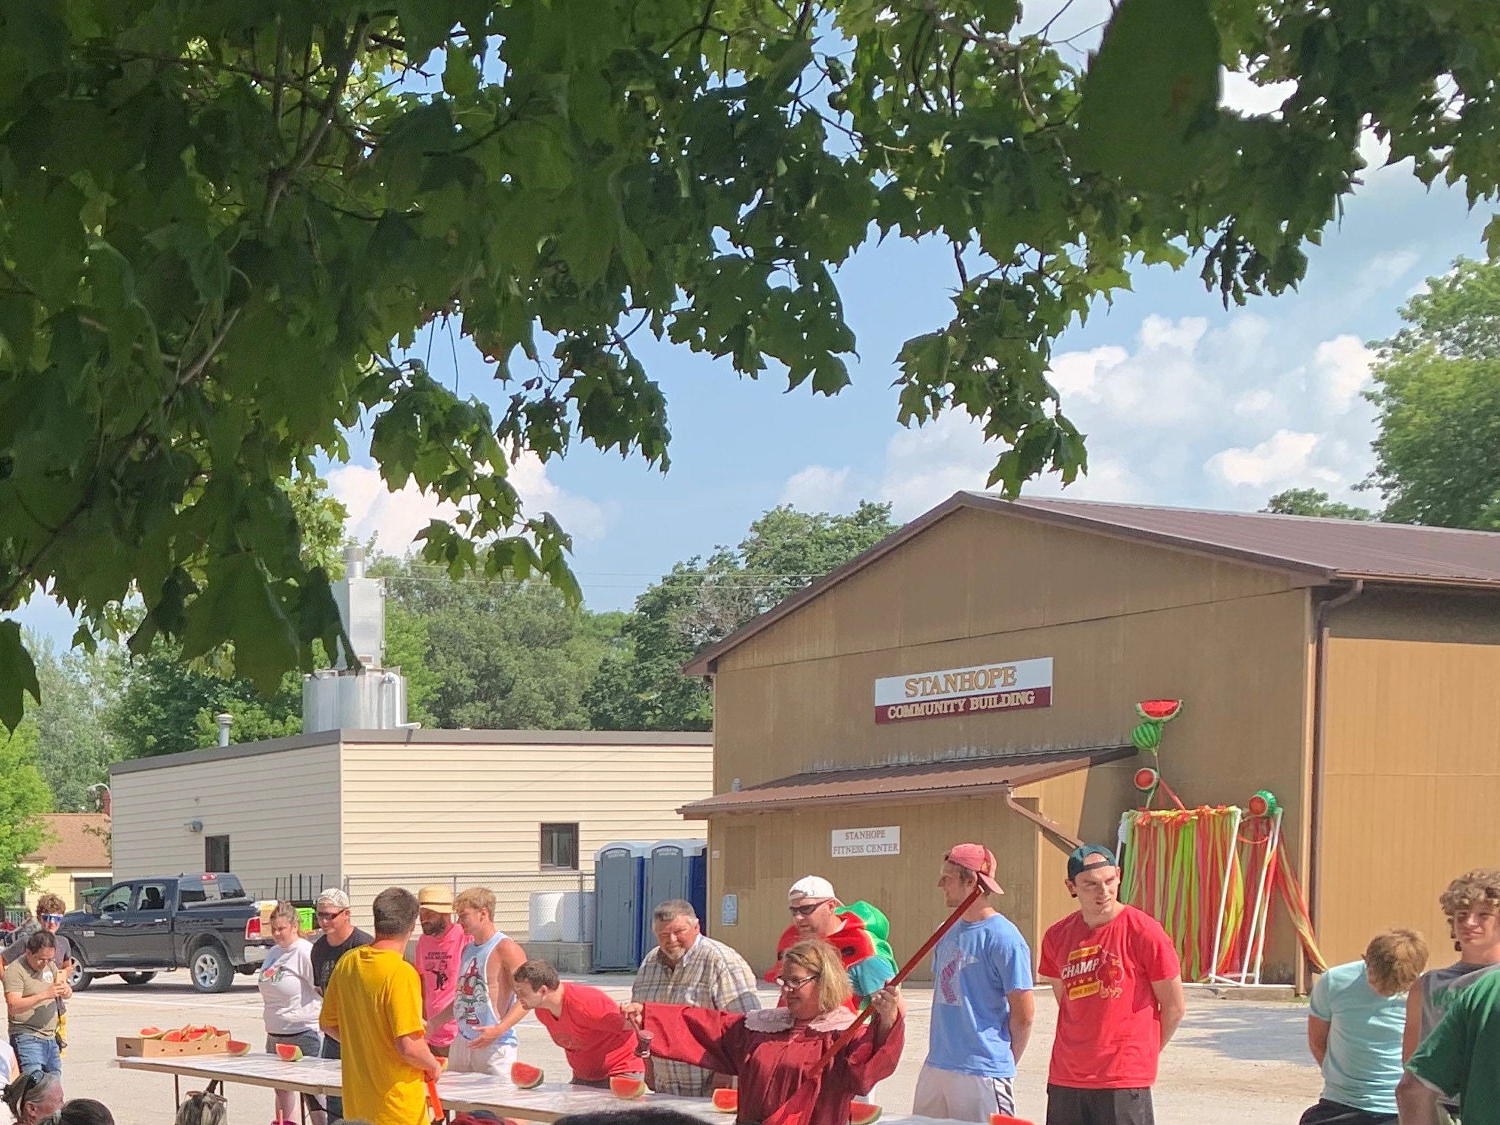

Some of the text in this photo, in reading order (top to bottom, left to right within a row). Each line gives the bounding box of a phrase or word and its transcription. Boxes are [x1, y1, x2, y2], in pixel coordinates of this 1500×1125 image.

[905, 666, 1017, 698] STANHOPE
[888, 691, 1035, 719] COMMUNITY BUILDING
[845, 830, 886, 840] STANHOPE
[833, 843, 898, 854] FITNESS CENTER
[1061, 958, 1100, 980] CHAMP
